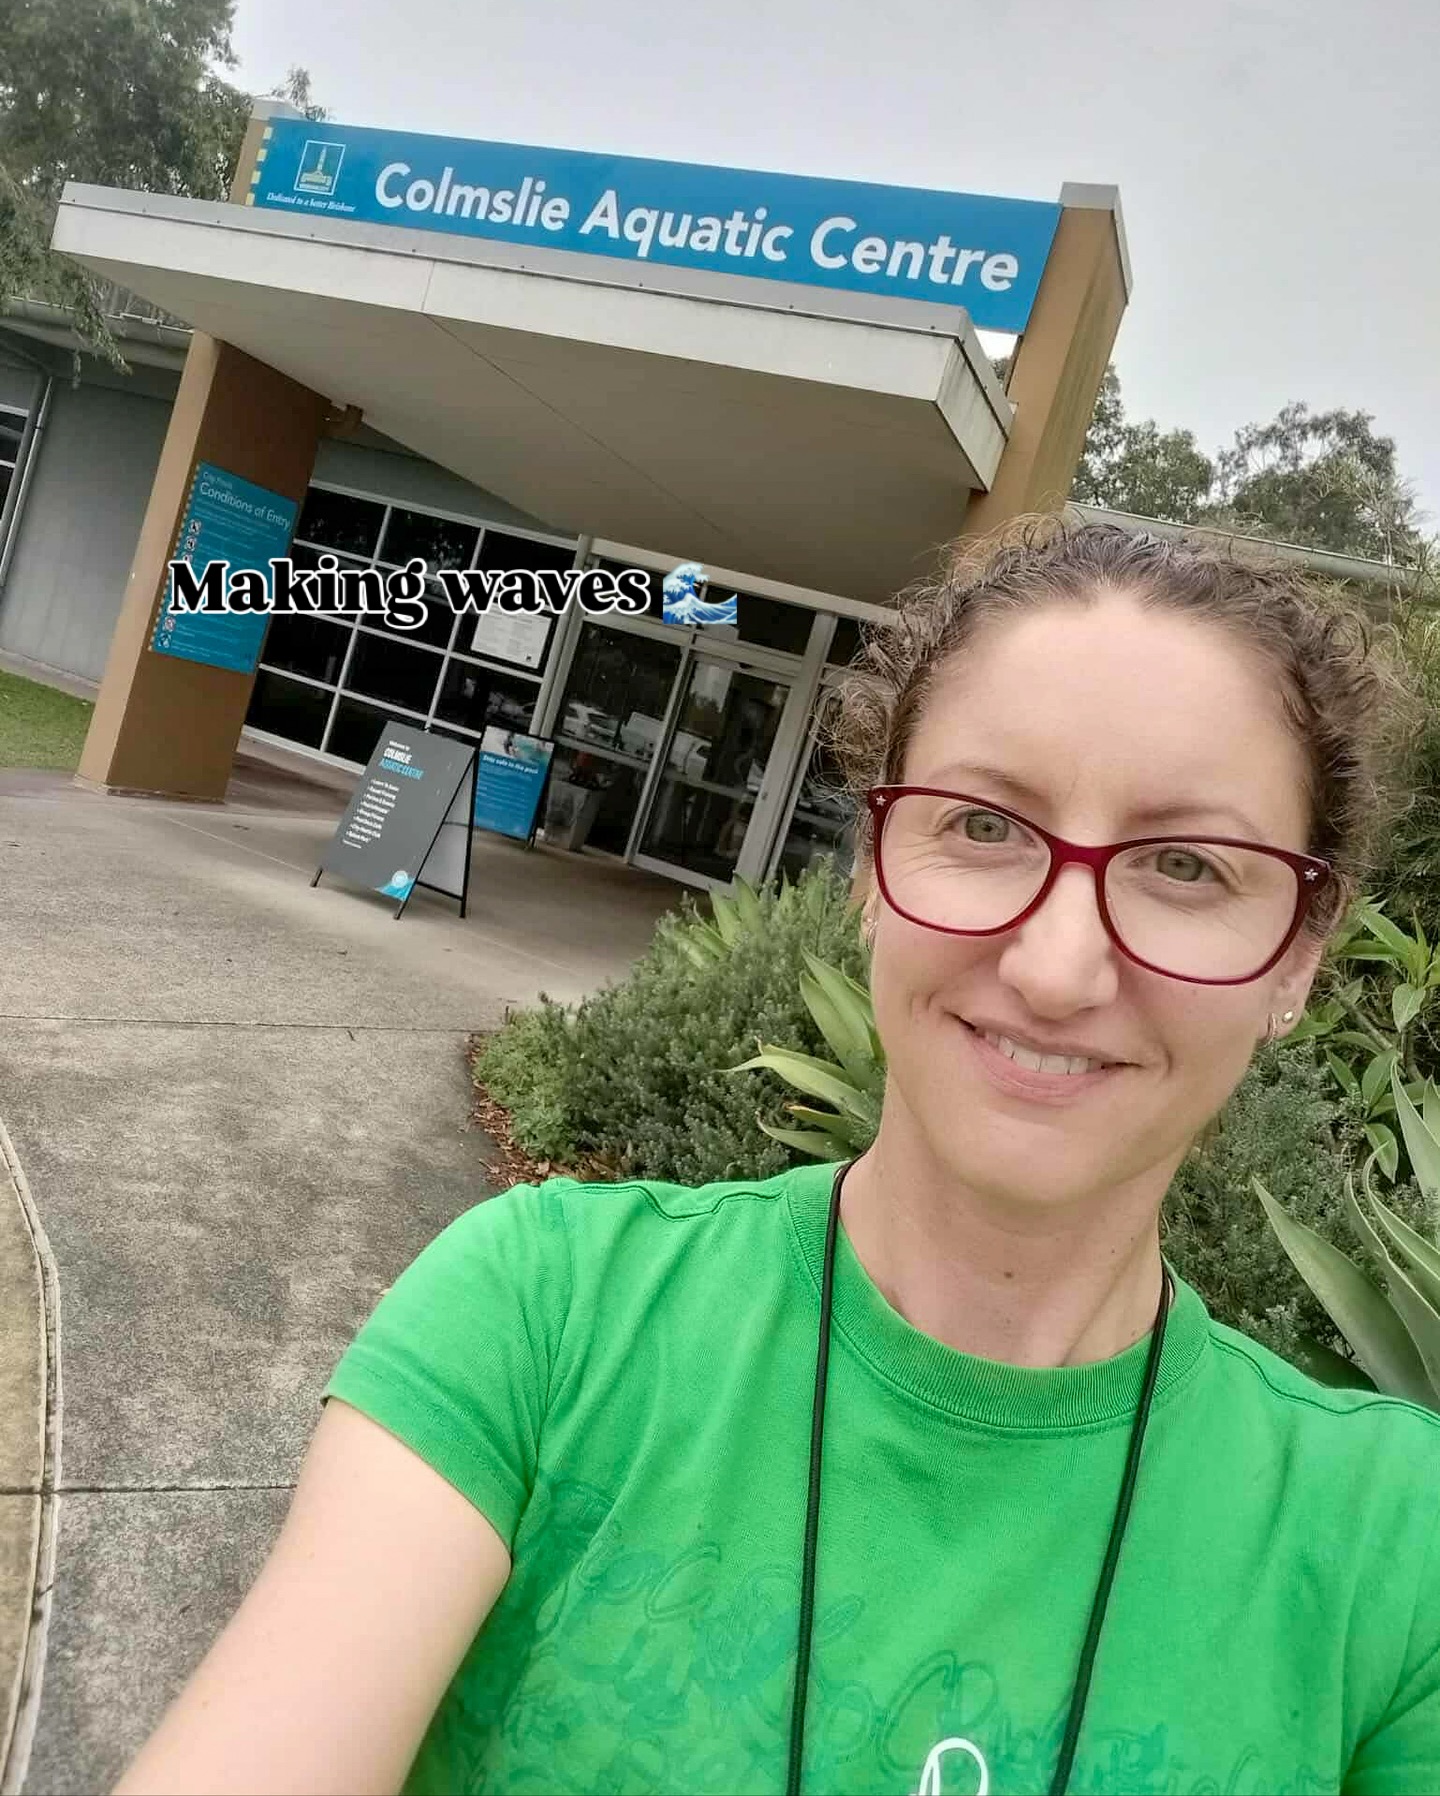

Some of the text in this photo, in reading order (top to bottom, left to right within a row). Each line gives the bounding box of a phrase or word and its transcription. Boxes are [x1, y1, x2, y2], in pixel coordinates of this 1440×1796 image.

[376, 163, 1018, 290] Colmslie Aquatic Centre
[200, 482, 253, 514] Conditions
[254, 506, 267, 518] of
[266, 509, 291, 530] Entry
